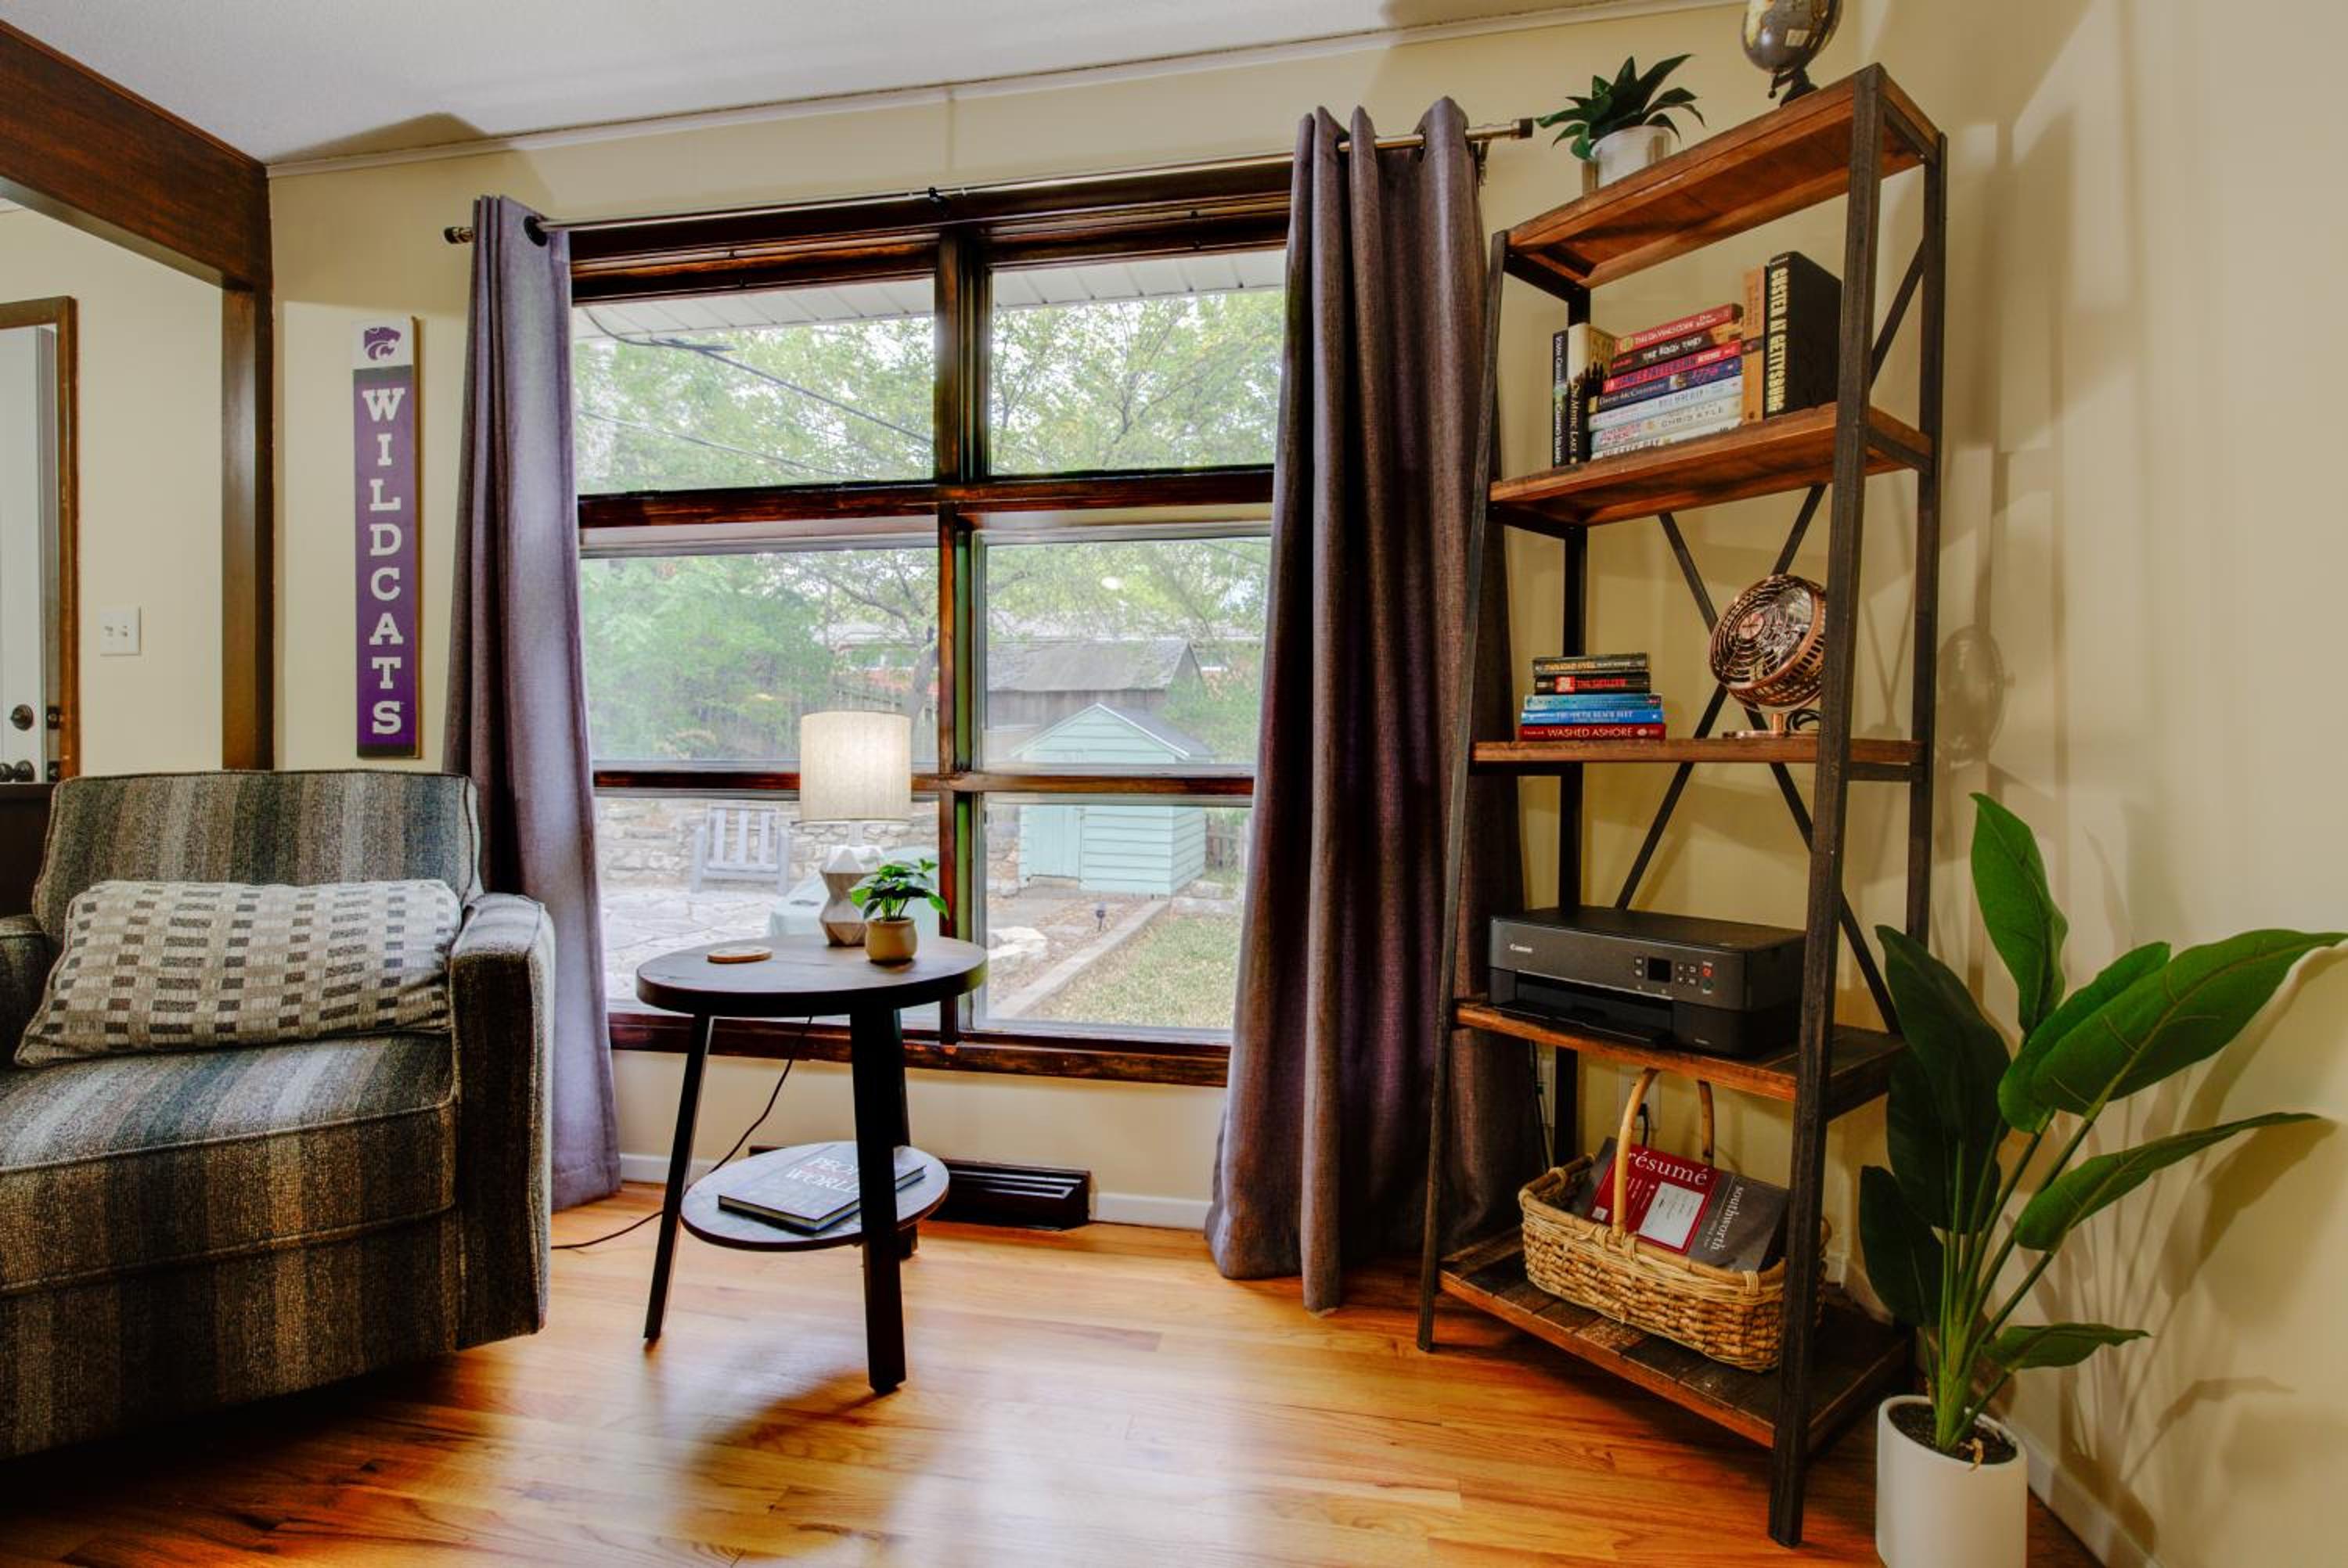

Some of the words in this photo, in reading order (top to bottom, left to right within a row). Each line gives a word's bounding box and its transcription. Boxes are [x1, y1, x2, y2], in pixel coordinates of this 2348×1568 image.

[1770, 268, 1789, 318] CUSTER
[1770, 319, 1788, 333] AT
[1767, 334, 1787, 413] GETTYSBURG
[362, 387, 405, 735] WILDCATS
[1547, 728, 1589, 737] WASHED
[1592, 727, 1633, 737] ASHORE
[1628, 1151, 1708, 1186] résumé
